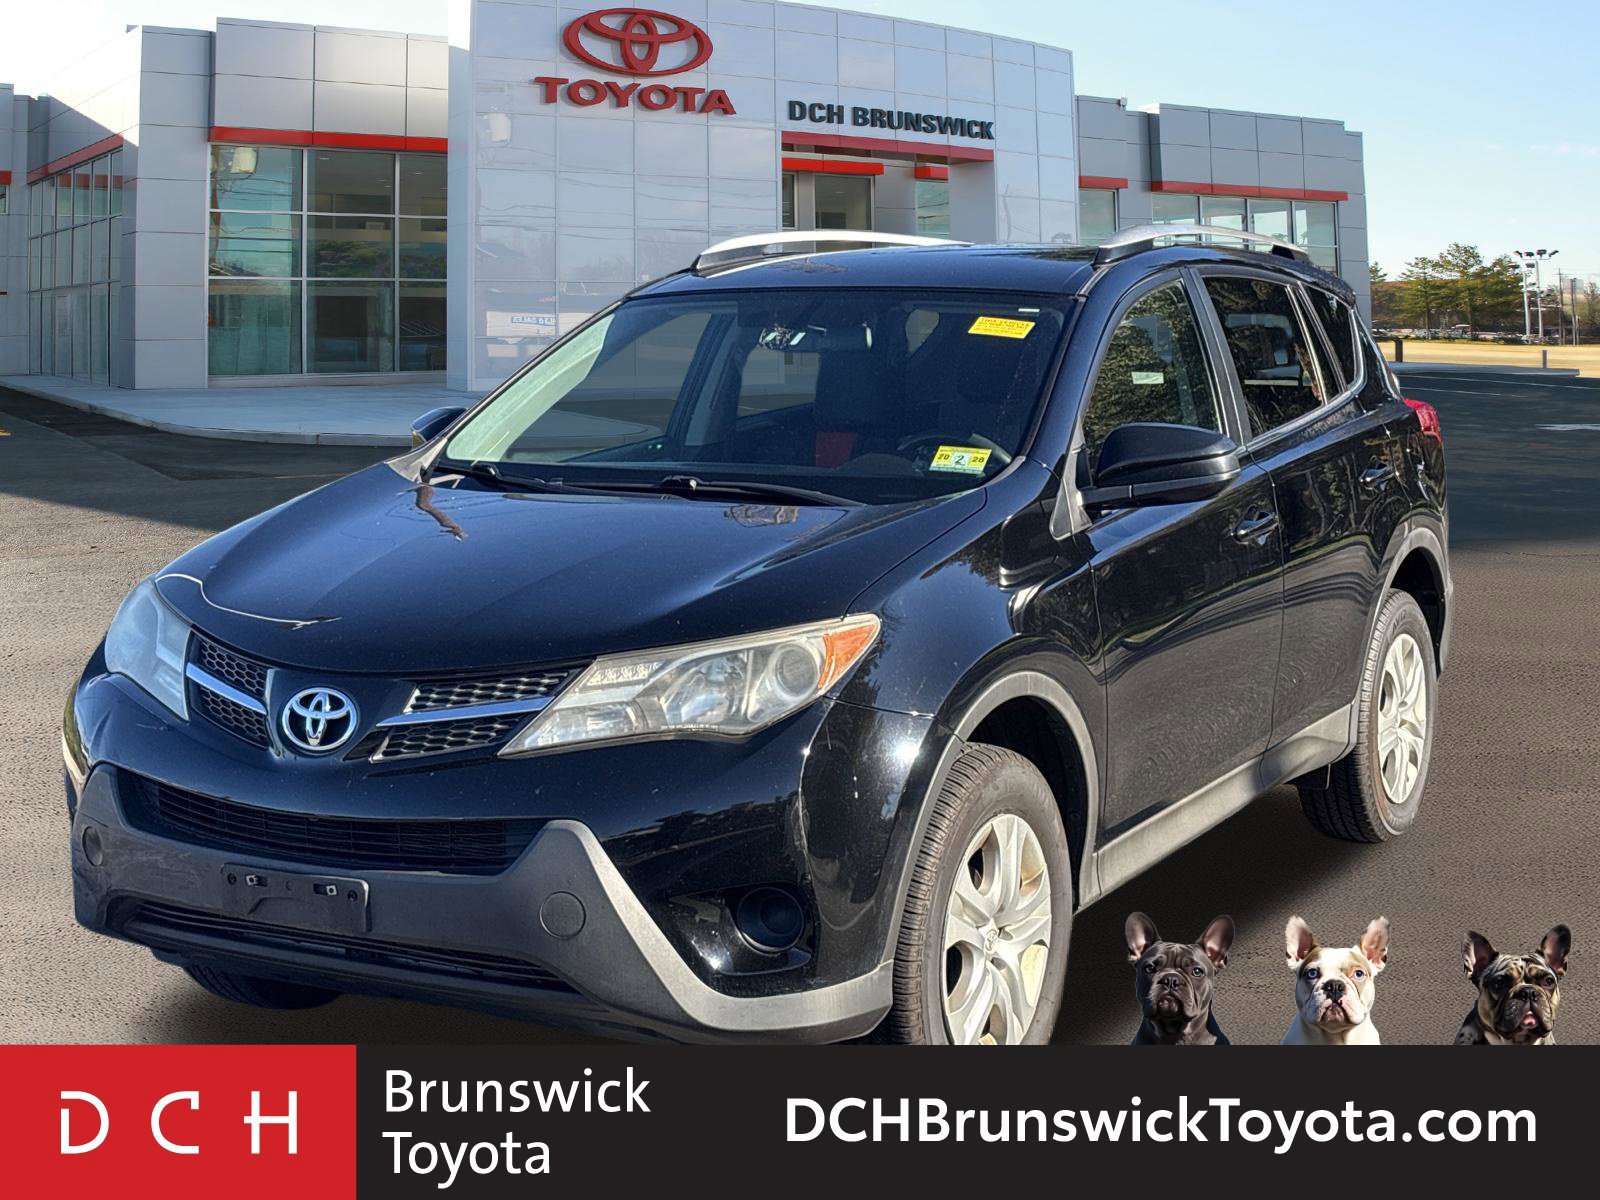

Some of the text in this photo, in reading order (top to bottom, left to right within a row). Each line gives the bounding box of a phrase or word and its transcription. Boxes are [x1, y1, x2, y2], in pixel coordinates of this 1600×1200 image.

[535, 77, 736, 115] TOYOTA
[788, 100, 995, 140] DCH BRUNSWICK
